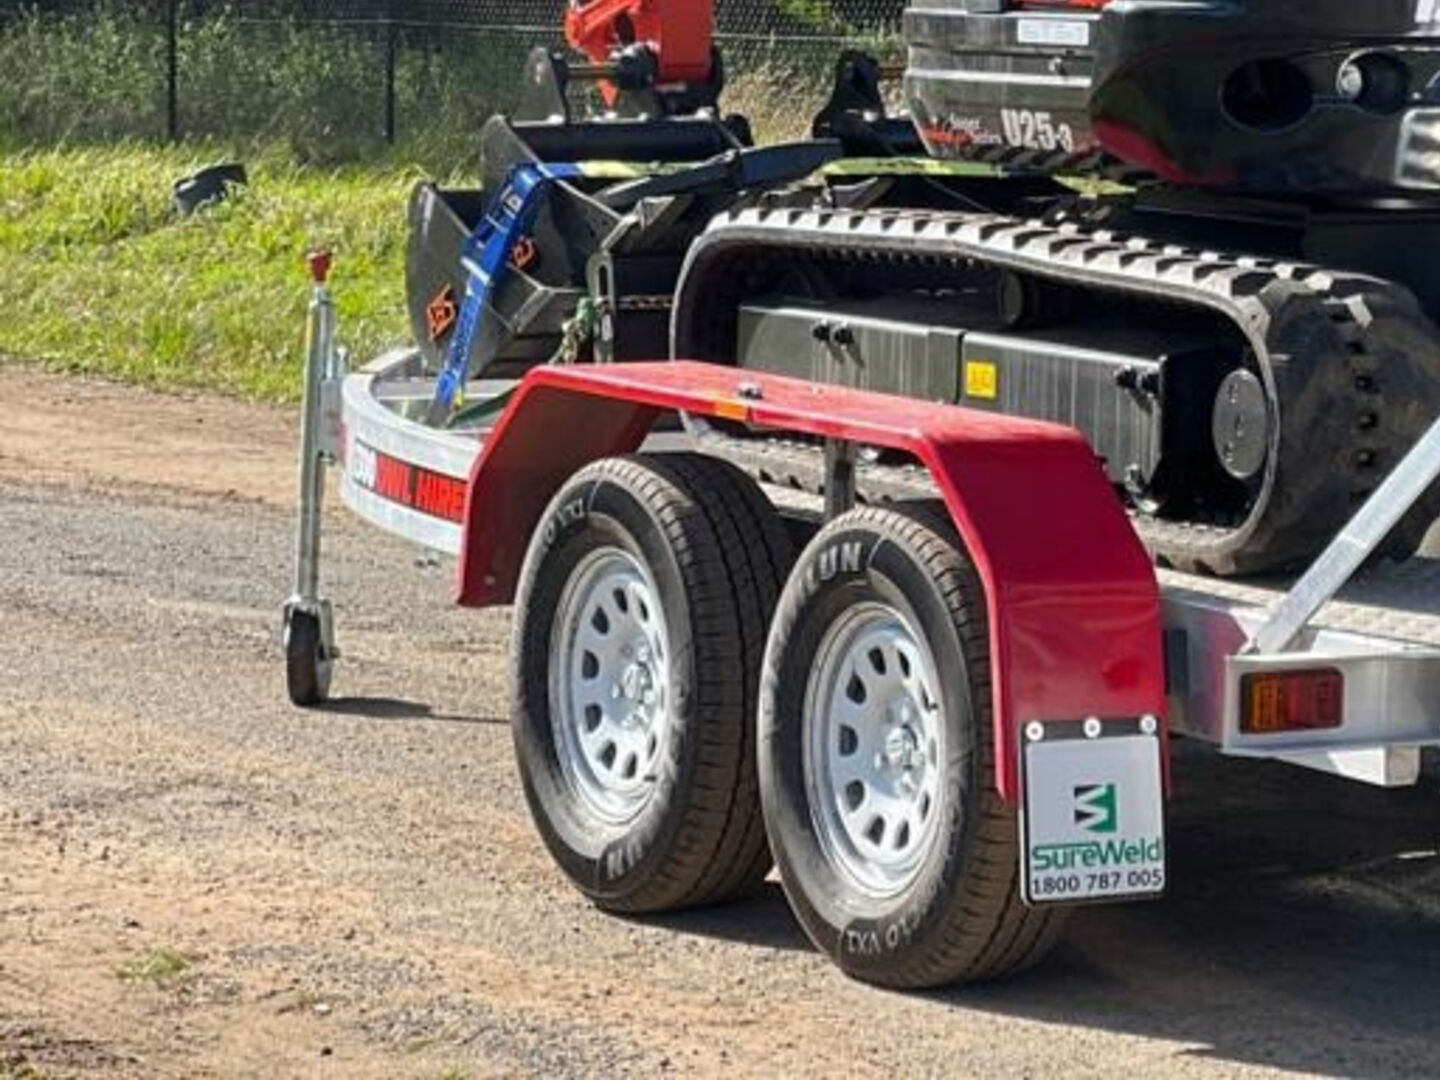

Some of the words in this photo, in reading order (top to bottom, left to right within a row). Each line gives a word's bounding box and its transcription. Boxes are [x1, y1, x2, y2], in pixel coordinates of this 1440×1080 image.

[1032, 838, 1163, 871] SureWeld
[1032, 874, 1081, 895] 1800
[1086, 871, 1121, 892] 787
[1127, 868, 1163, 887] 005
